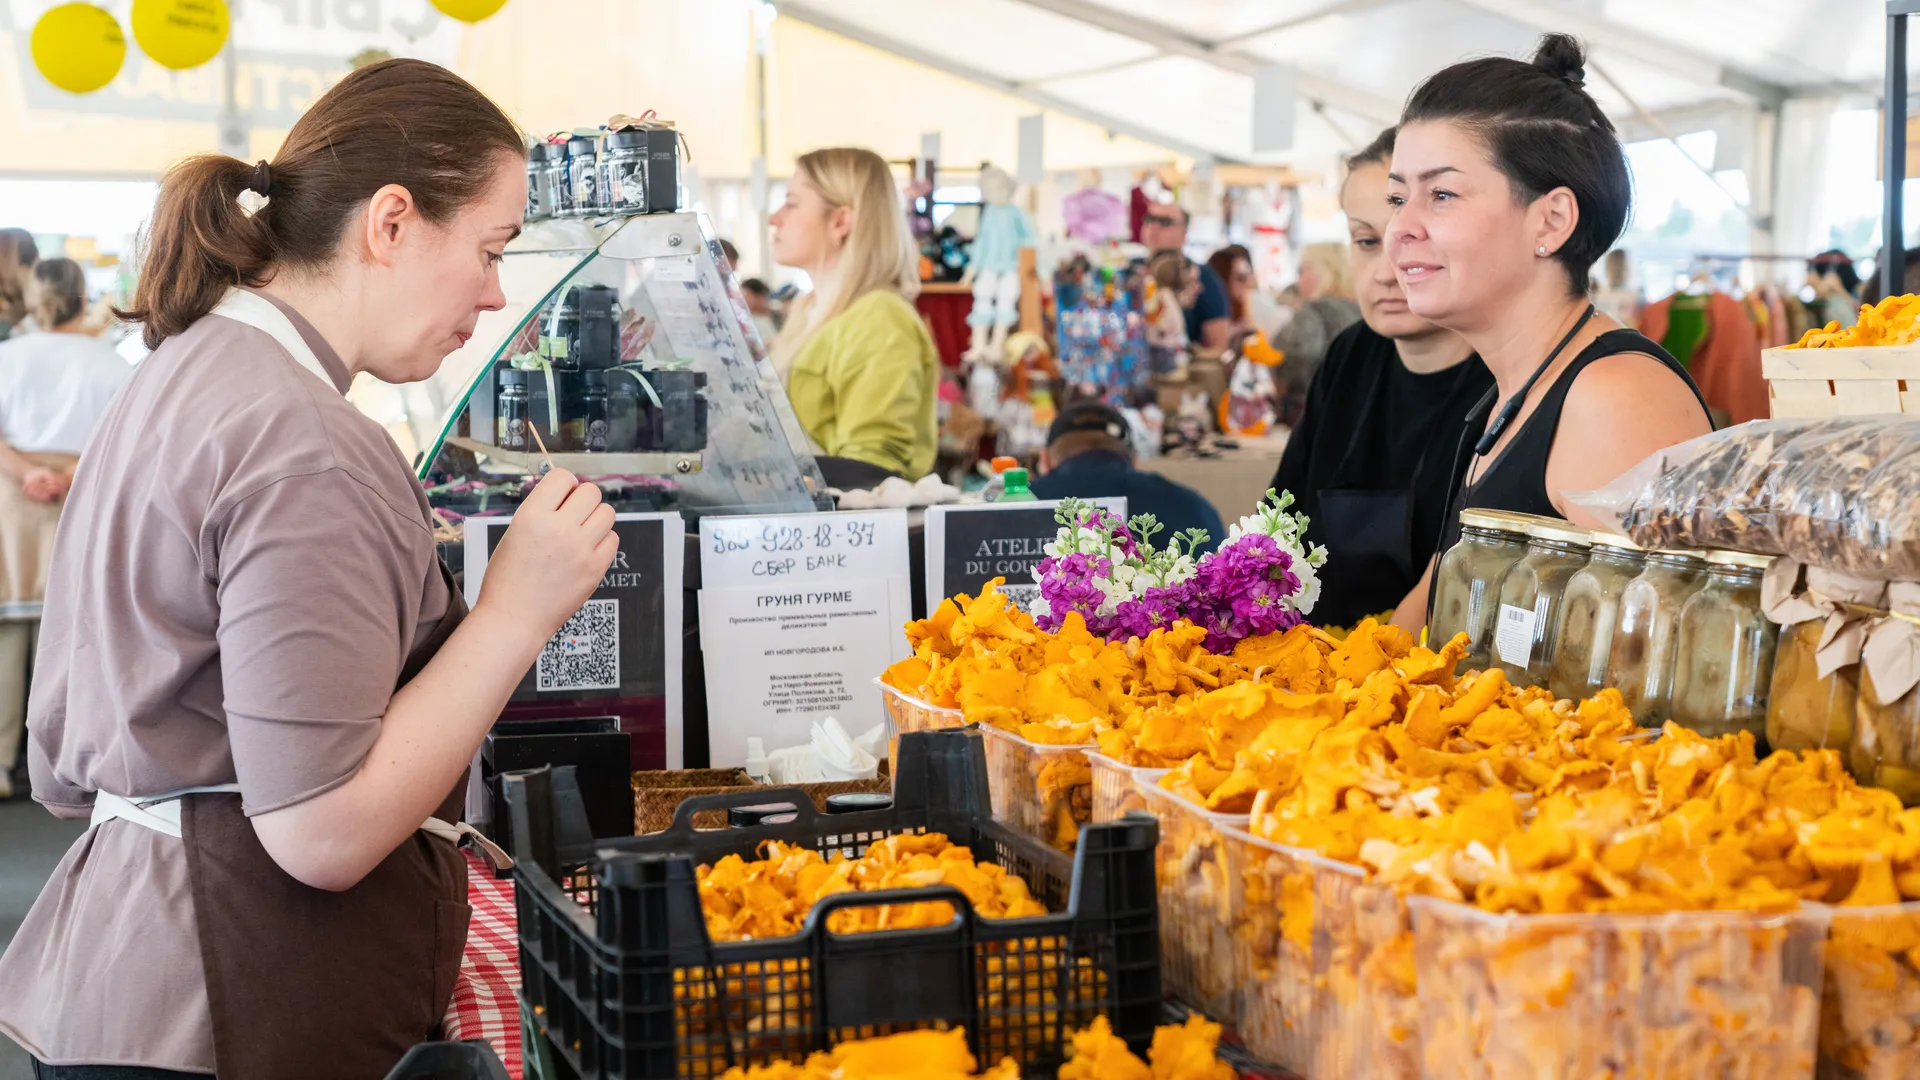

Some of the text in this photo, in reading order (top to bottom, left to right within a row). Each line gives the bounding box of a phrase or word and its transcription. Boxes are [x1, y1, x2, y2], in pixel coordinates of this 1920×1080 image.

[806, 554, 847, 571] БАНК
[965, 560, 991, 575] DU
[757, 591, 853, 607] ГРУНЯ ГУРМЕ
[778, 613, 827, 622] премиальных
[829, 610, 877, 619] ремесленных
[776, 646, 831, 656] НОВГОРОДОВА
[833, 645, 846, 653] И.Б.
[784, 679, 843, 689] Наро-Фоминский
